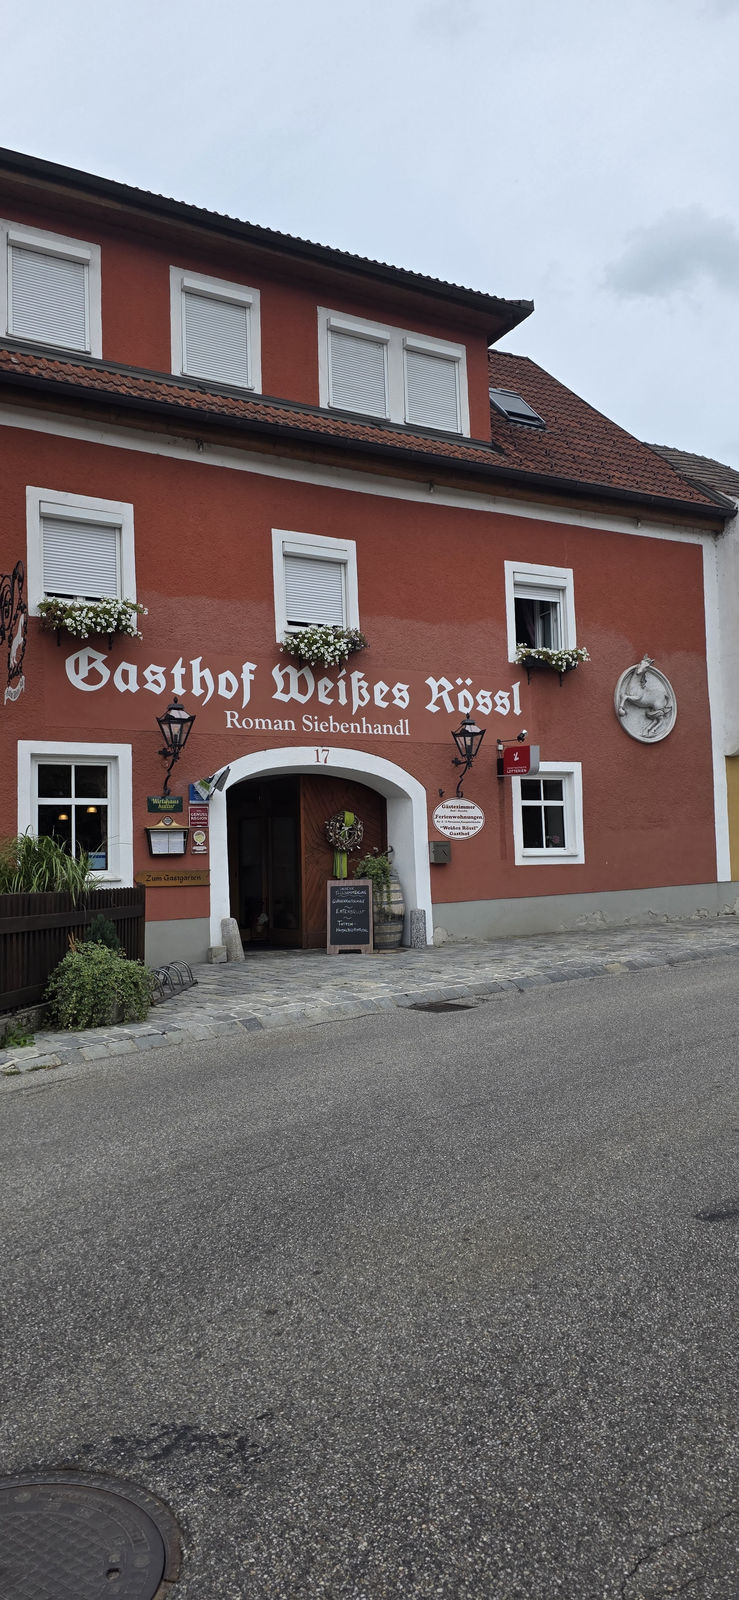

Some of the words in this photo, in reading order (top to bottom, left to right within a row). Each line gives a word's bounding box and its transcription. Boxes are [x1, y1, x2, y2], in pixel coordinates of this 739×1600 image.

[65, 646, 258, 709] Gasthof
[271, 663, 411, 715] Weißes
[425, 676, 522, 717] Rössl
[224, 710, 297, 732] Roman
[302, 714, 411, 736] Siebenhandl
[314, 748, 330, 764] 17
[146, 874, 162, 882] Zum
[163, 874, 201, 883] Gastgarten
